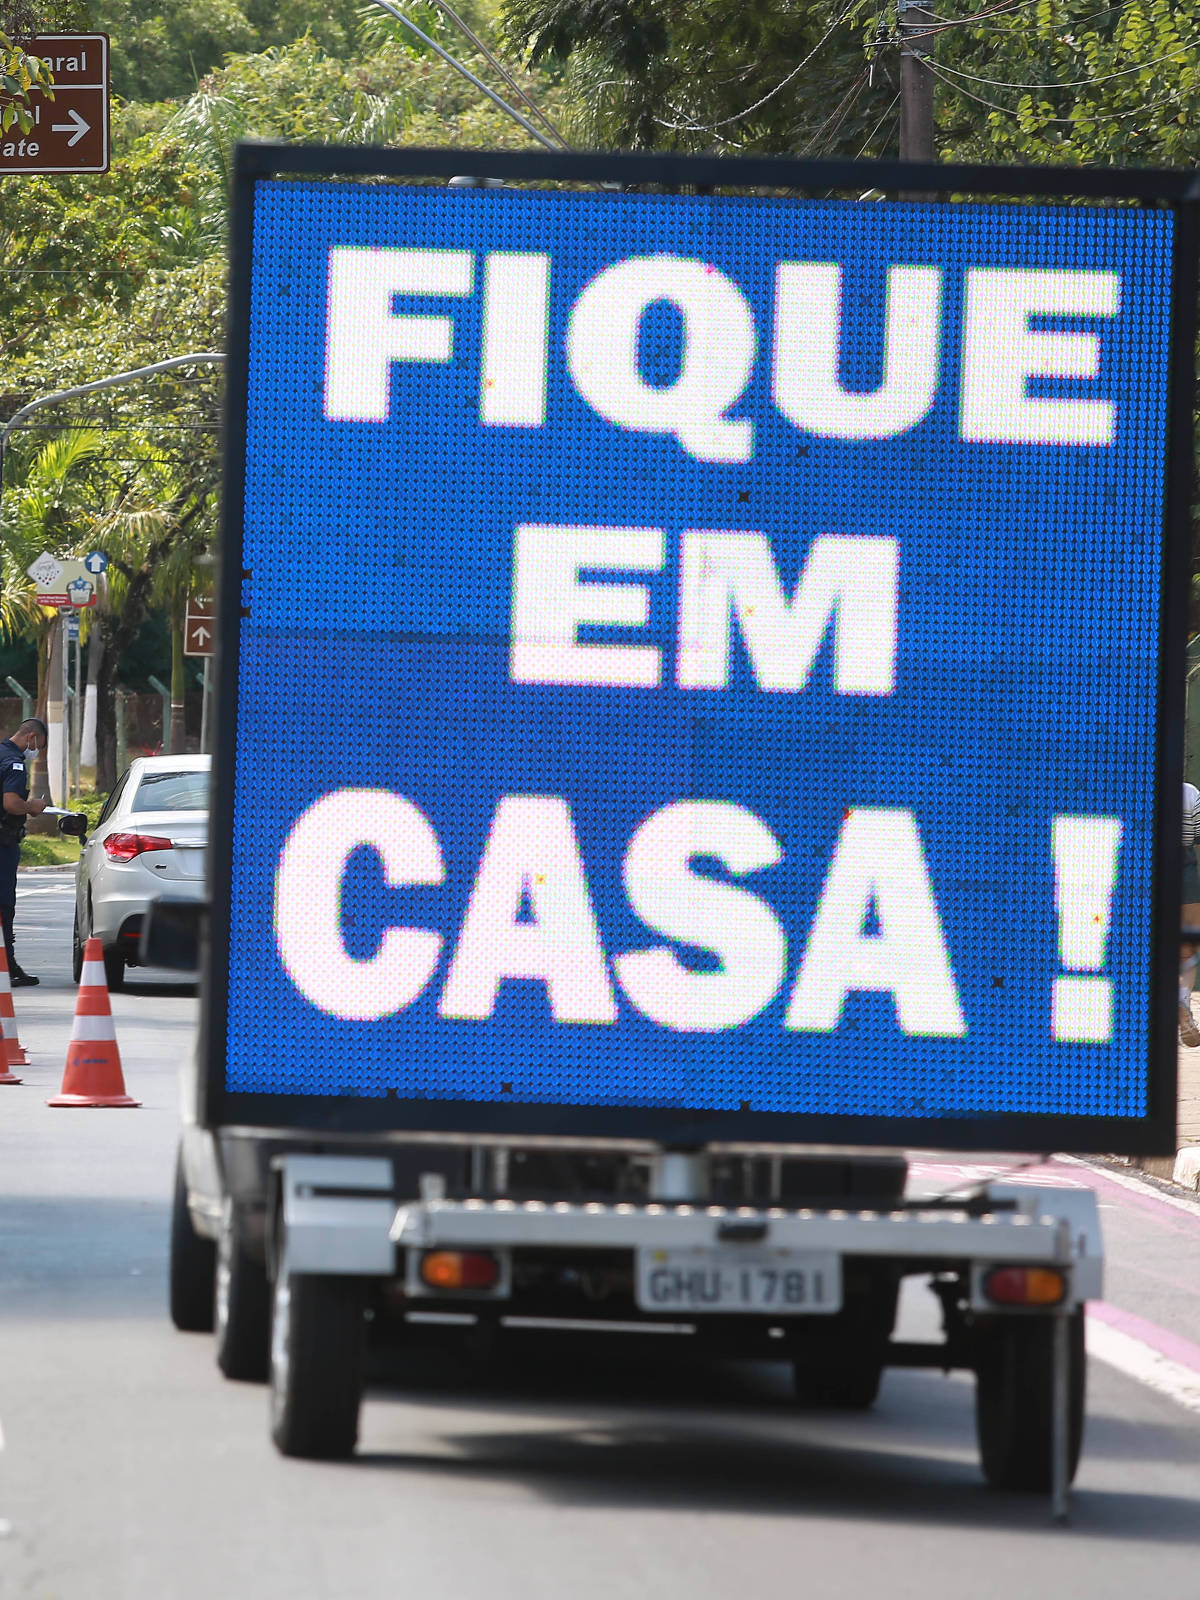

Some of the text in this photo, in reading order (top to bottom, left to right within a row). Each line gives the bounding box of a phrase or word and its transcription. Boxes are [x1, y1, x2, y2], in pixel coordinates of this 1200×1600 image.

[323, 243, 1123, 463] FIQUE
[509, 522, 900, 697] EM
[274, 787, 968, 1038] CASA
